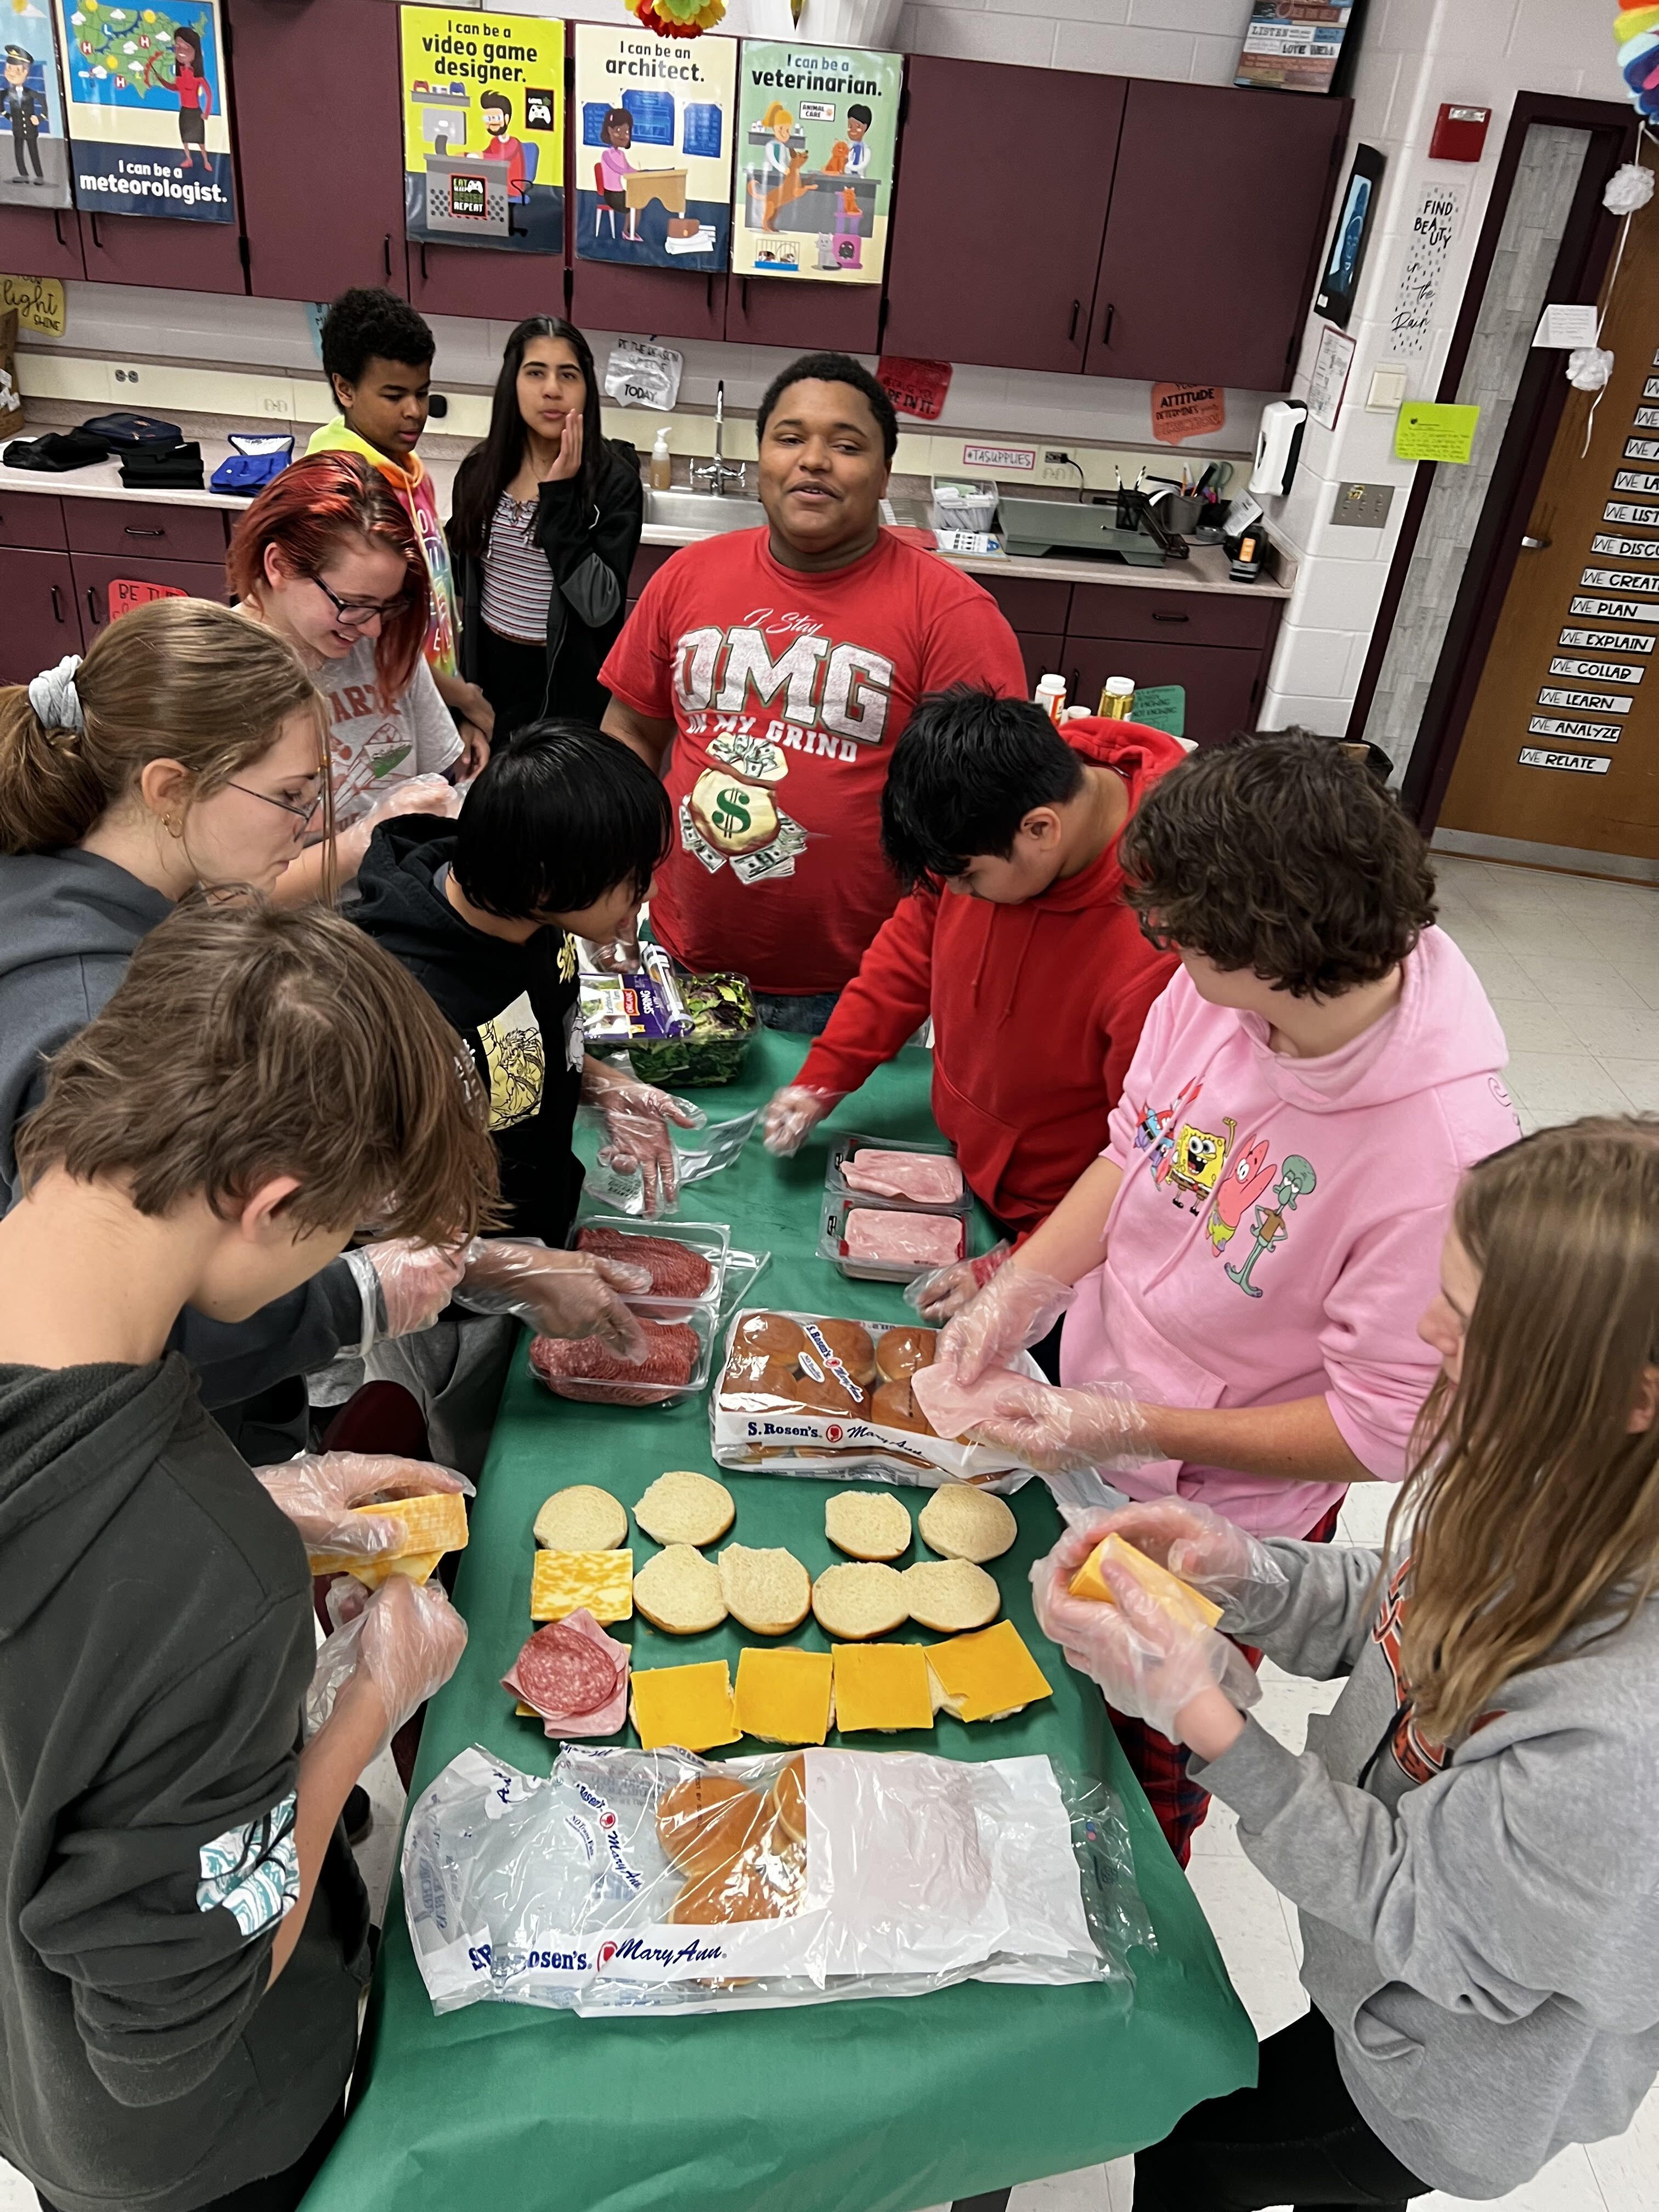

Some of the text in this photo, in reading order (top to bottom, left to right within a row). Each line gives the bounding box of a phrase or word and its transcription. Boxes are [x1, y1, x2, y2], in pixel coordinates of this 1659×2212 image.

[448, 19, 511, 38] I can be a
[1252, 26, 1289, 37] LISTEN
[422, 33, 538, 64] video game
[620, 41, 691, 59] I can be an
[1282, 44, 1307, 55] LOVE
[434, 56, 527, 84] designer.
[605, 58, 705, 82] architect.
[787, 53, 849, 71] I can be a
[752, 69, 882, 97] veterinarian.
[803, 104, 825, 112] ANIMAL
[119, 159, 183, 179] I can be a
[80, 174, 228, 205] meteorologist.
[454, 201, 483, 212] REPEAT
[1423, 200, 1453, 216] FIND
[1414, 217, 1452, 249] BEAUTY
[3, 279, 58, 317] light
[1391, 311, 1431, 331] Rain
[1160, 387, 1215, 408] ATTITUDE
[1638, 409, 1659, 425] WE
[1628, 439, 1652, 456] WE
[1618, 472, 1641, 488] WE
[1606, 504, 1629, 520] WE
[1594, 536, 1617, 552] WE
[1583, 570, 1606, 584] WE
[118, 583, 140, 601] BE
[1573, 597, 1639, 617] WE PLAN
[743, 607, 824, 637] I Stay
[1562, 631, 1649, 650] WE EXPLAIN
[1552, 658, 1632, 680] WE COLLAB
[672, 626, 895, 745] OMG
[1542, 690, 1615, 709] WE LEARN
[1531, 716, 1620, 739] WE ANALYZE
[685, 713, 858, 763] ON MY GRIND
[1521, 750, 1597, 769] WE RELATE
[624, 991, 635, 1014] ORGANIC
[640, 990, 654, 1014] SPRING
[747, 1421, 761, 1436] S.
[847, 1425, 888, 1444] Mary
[570, 1815, 582, 1826] NO
[607, 1830, 627, 1870] Mary
[616, 1938, 674, 1968] Mary
[675, 1938, 722, 1962] Ann
